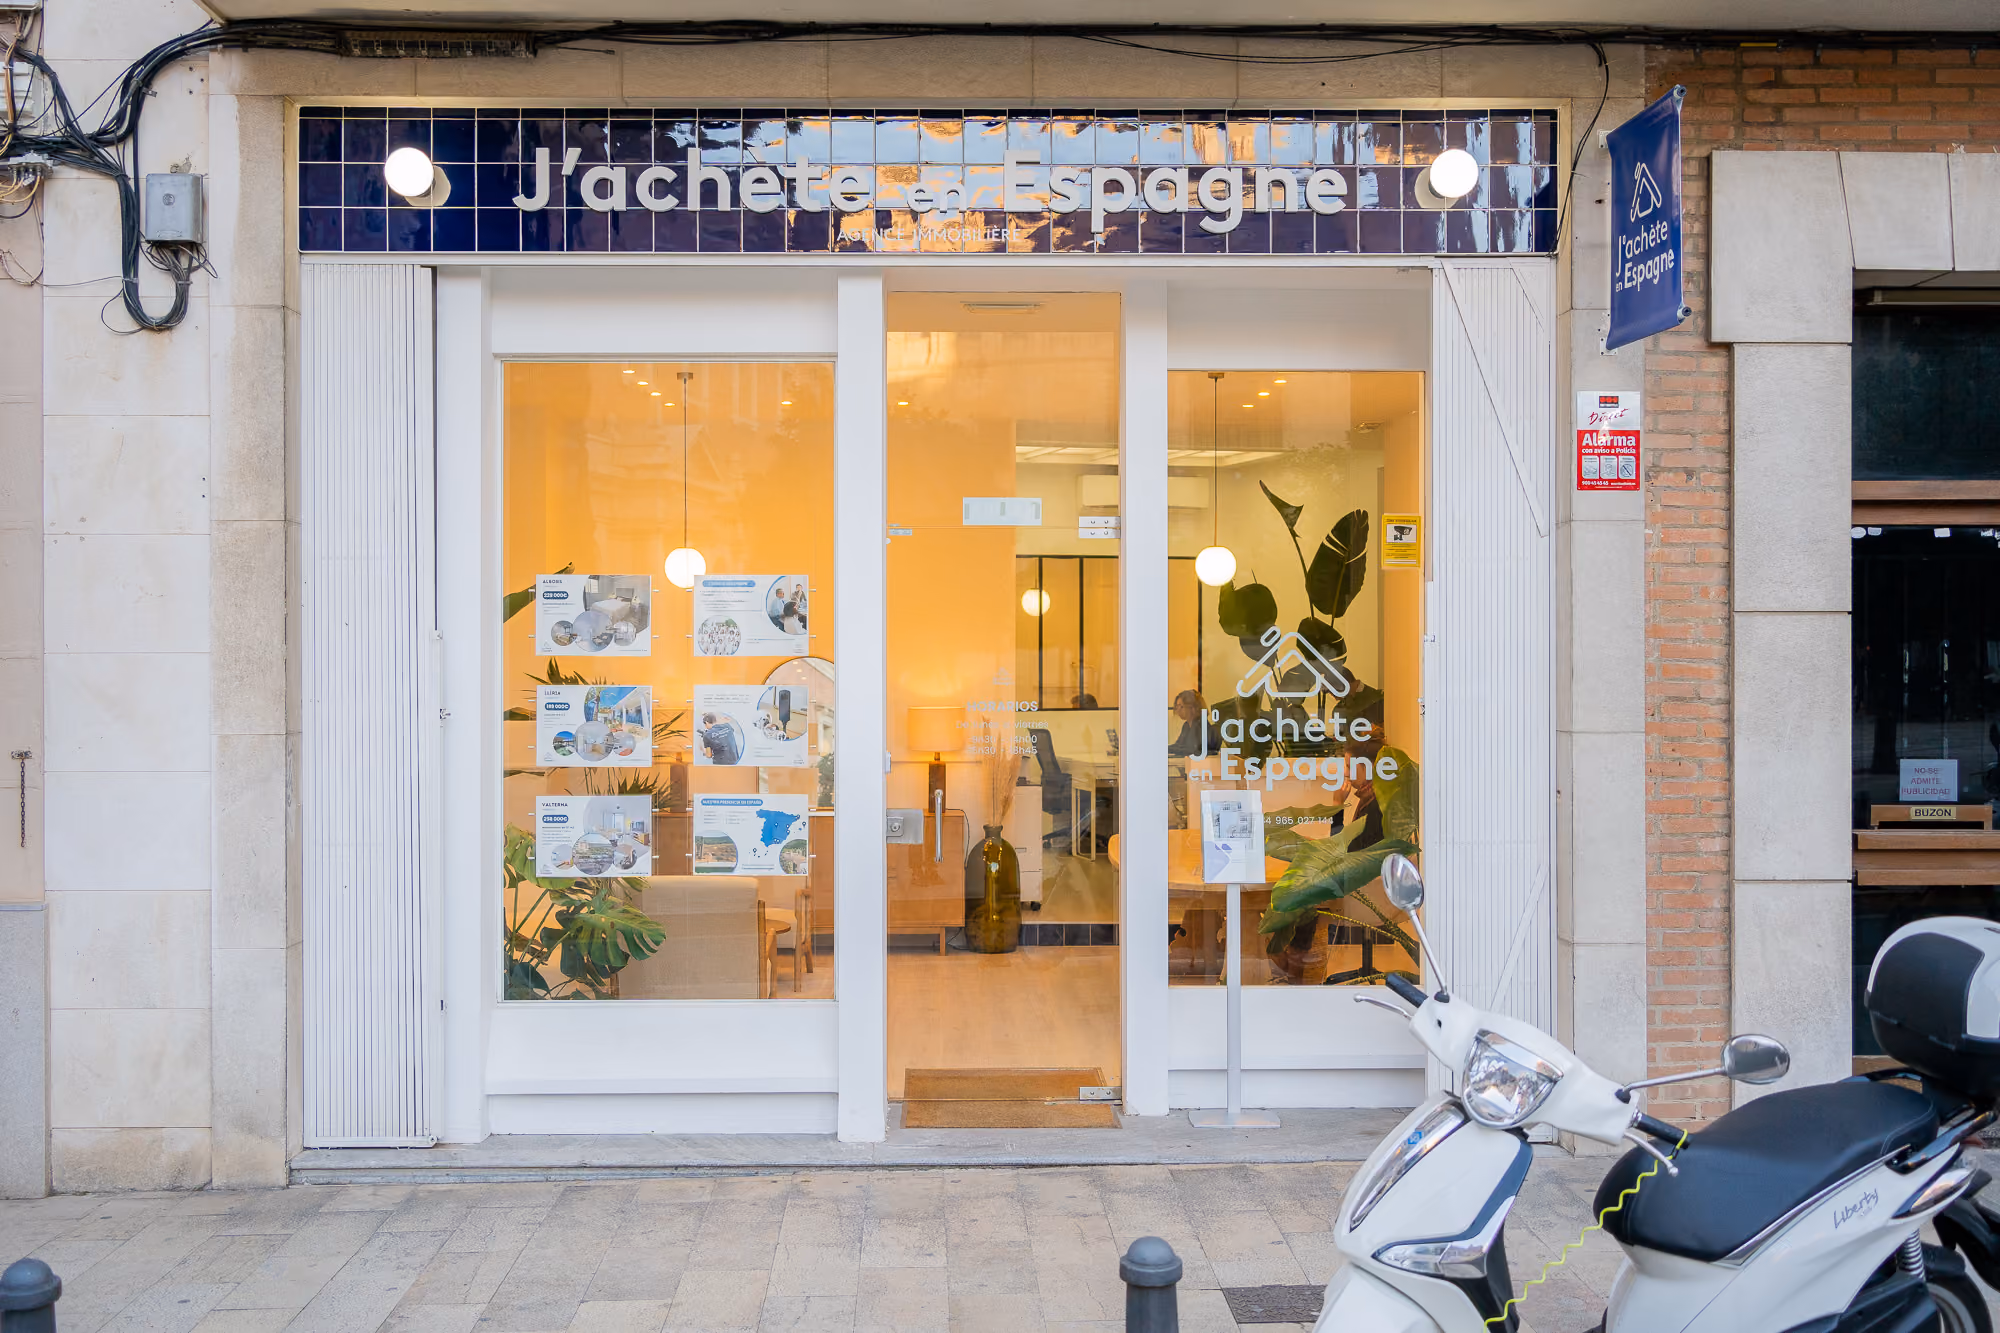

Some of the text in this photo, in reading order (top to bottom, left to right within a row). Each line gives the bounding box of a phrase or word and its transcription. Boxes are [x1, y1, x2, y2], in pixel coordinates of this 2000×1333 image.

[512, 147, 1349, 234] J'achète en Espagne
[837, 225, 1022, 242] AGENCE IMMOBILIÈRE
[1615, 220, 1668, 277] J'achète
[1615, 248, 1675, 292] en Espagne
[1582, 432, 1636, 446] Alarma
[966, 701, 1039, 712] HORARIOS
[1188, 708, 1373, 762] J'achète
[1188, 748, 1399, 791] en Espagne
[1911, 777, 1940, 785] ADMITE
[1275, 816, 1294, 825] 965
[1297, 816, 1315, 825] 027
[1914, 808, 1952, 816] BUZON
[1833, 1187, 1879, 1229] Liberty
